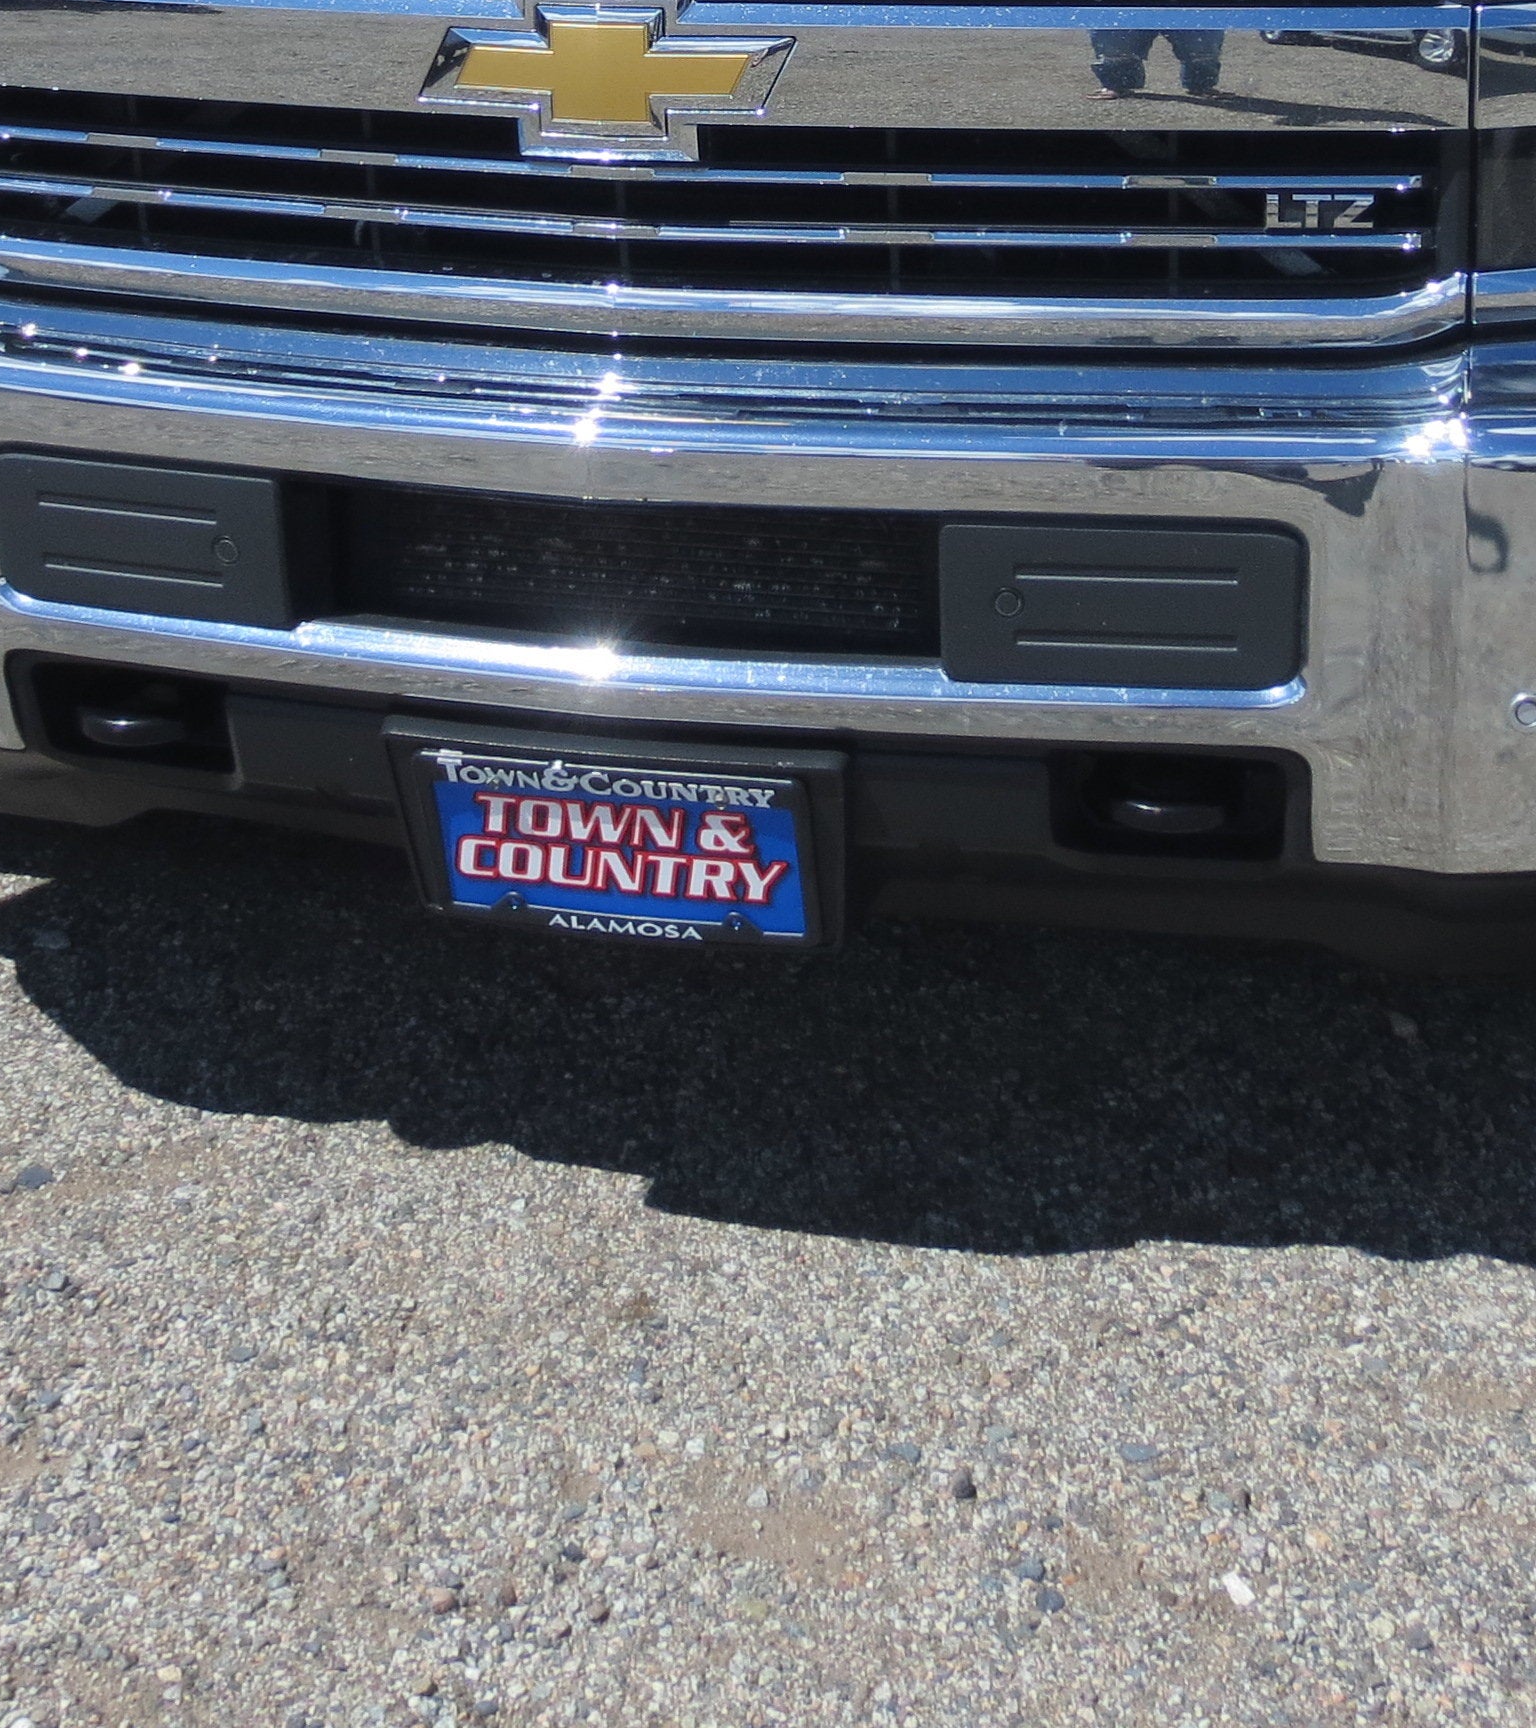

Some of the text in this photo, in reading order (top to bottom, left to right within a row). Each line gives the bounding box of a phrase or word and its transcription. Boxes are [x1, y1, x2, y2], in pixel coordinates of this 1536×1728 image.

[1266, 194, 1374, 228] LTZ
[475, 792, 754, 854] TOWN &
[457, 836, 787, 904] COUNTRY
[548, 914, 702, 941] ALAMOSA
